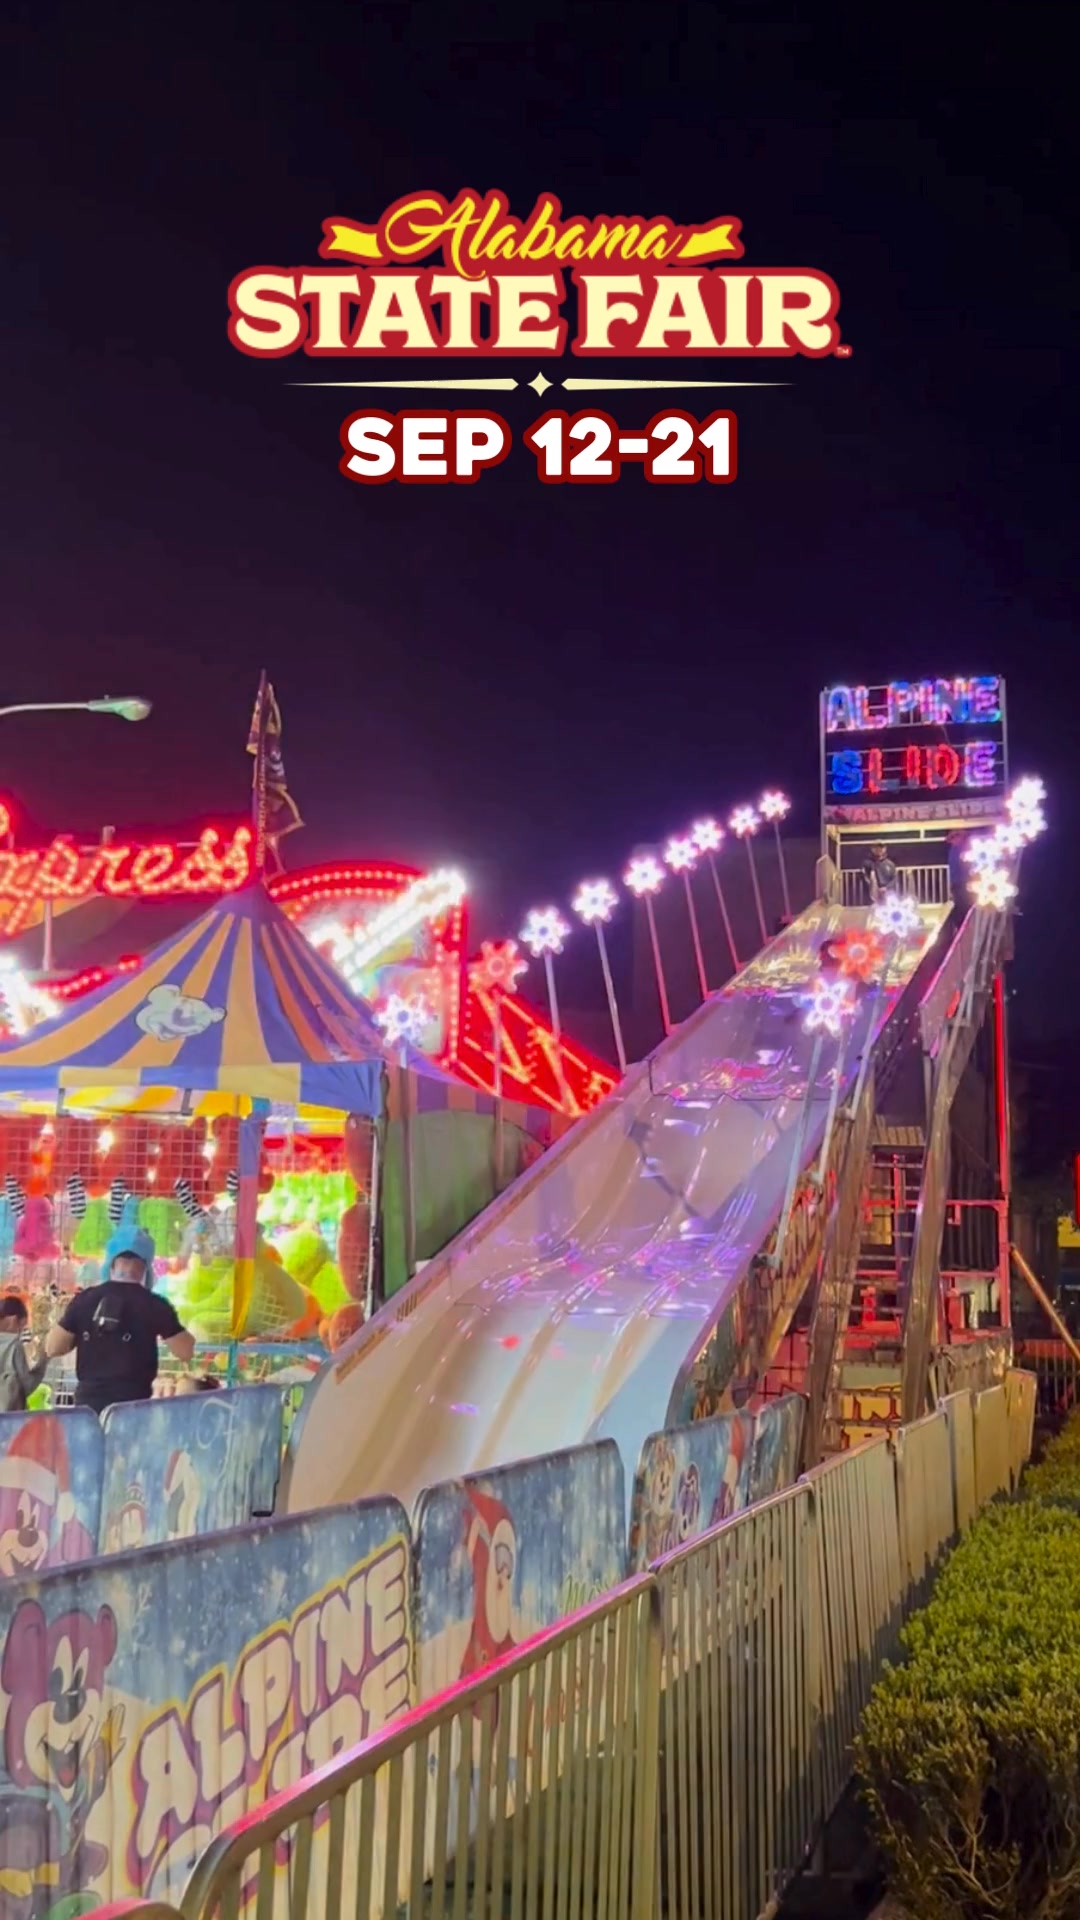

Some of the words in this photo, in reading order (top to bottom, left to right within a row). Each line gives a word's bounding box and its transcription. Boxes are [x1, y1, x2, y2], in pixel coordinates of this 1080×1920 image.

[826, 676, 1001, 732] ALPINE
[832, 741, 996, 793] SLIDE
[852, 806, 929, 822] ALPINE
[934, 801, 996, 818] SLIDE
[0, 803, 251, 934] xpress
[134, 1545, 407, 1860] ALPINE
